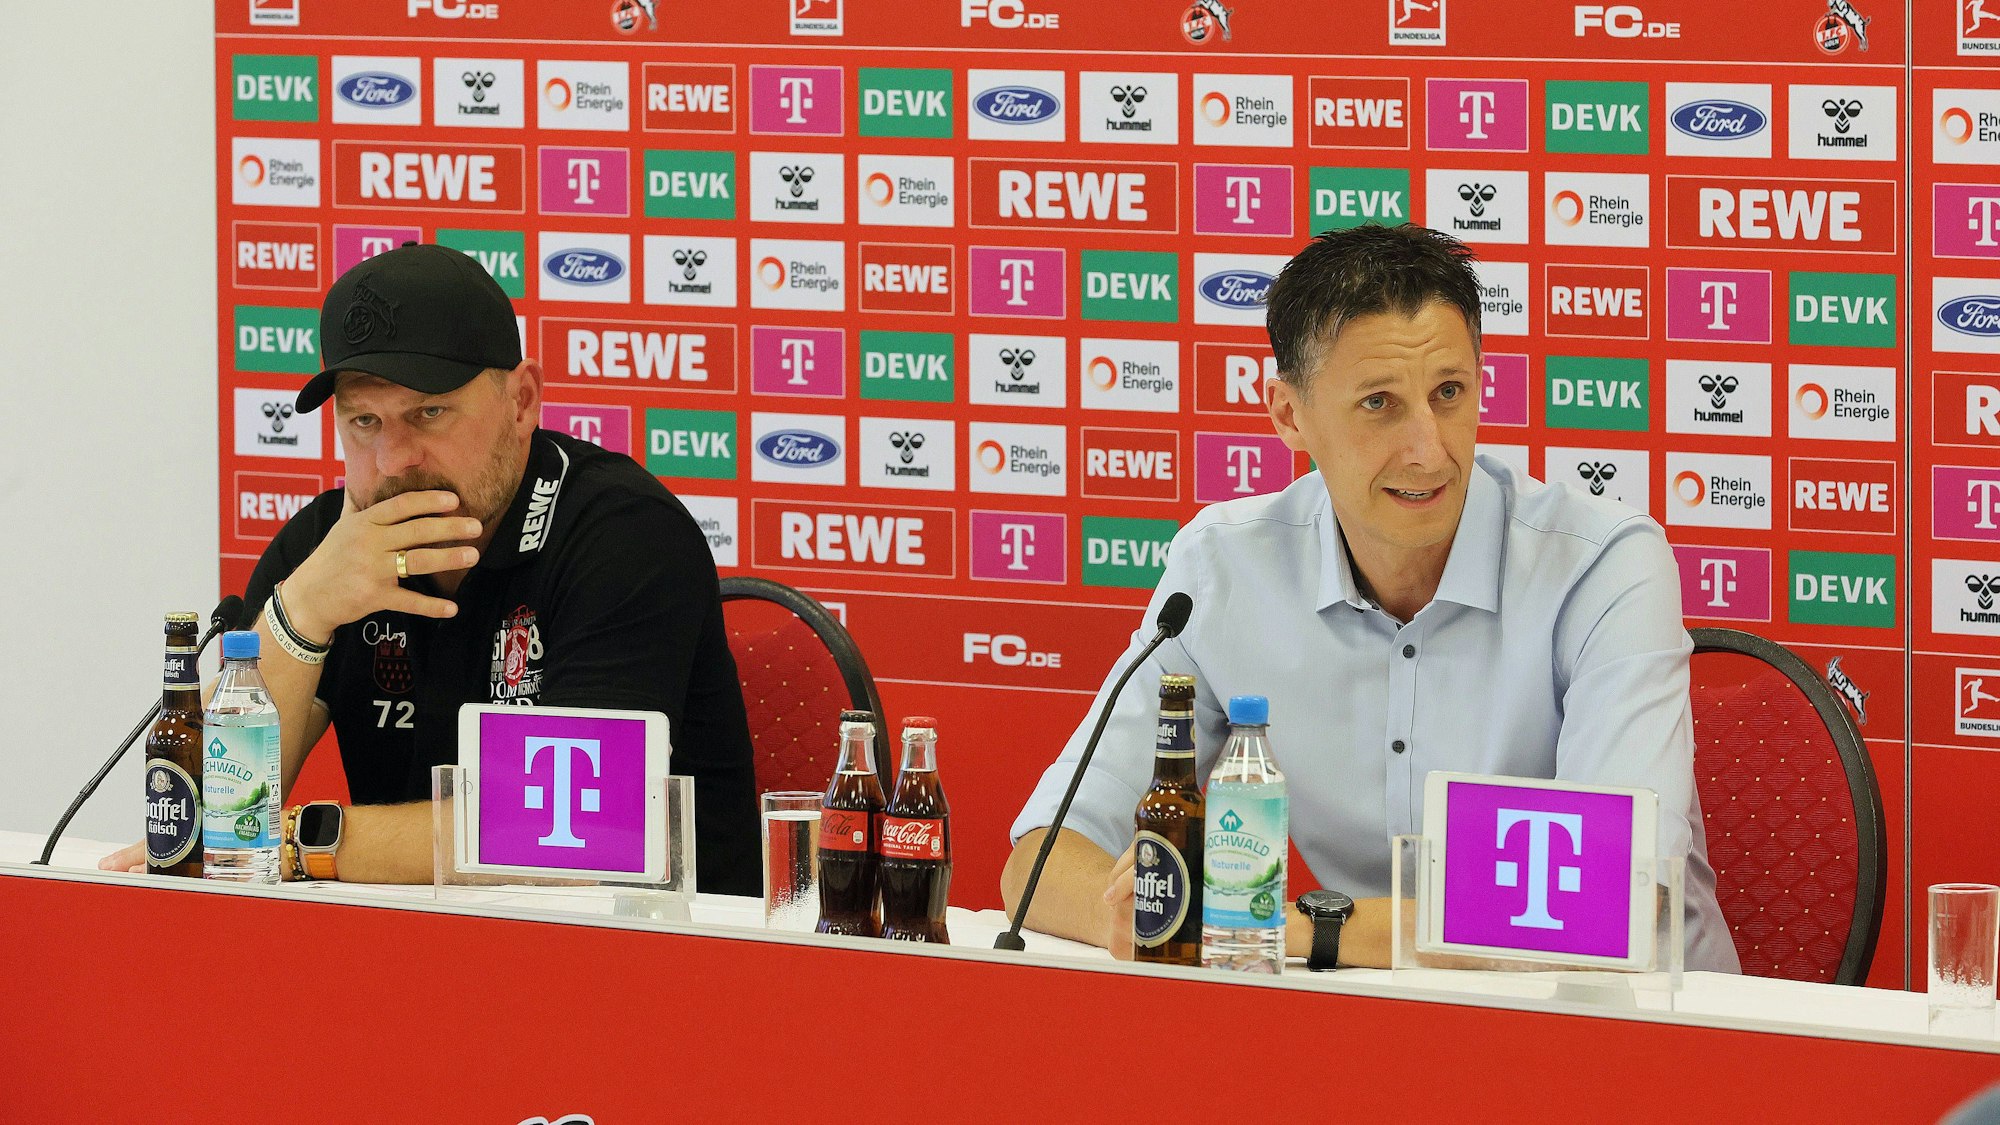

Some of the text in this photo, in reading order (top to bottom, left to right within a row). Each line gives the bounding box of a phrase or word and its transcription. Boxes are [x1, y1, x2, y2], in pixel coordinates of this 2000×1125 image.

[408, 0, 497, 18] FC.DE
[961, 0, 1059, 28] FC.DE
[1575, 6, 1680, 38] FC.DE
[238, 75, 312, 101] DEVK
[352, 78, 399, 105] Ford
[577, 82, 611, 95] Rhein
[649, 84, 729, 112] REWE
[780, 78, 812, 123] T
[459, 104, 499, 114] hummel
[577, 96, 623, 112] Energie
[865, 90, 946, 116] DEVK
[990, 92, 1042, 117] Ford
[1236, 97, 1273, 110] Rhein
[1315, 98, 1403, 127] REWE
[1460, 91, 1494, 139] T
[1107, 118, 1151, 131] hummel
[1237, 111, 1287, 127] Energie
[1552, 104, 1641, 131] DEVK
[1690, 106, 1747, 132] Ford
[1818, 134, 1867, 147] hummel
[269, 159, 303, 172] Rhein
[361, 152, 496, 201] REWE
[270, 172, 314, 188] Energie
[568, 159, 599, 204] T
[650, 171, 729, 198] DEVK
[899, 177, 935, 190] Rhein
[776, 198, 818, 210] hummel
[899, 191, 948, 208] Energie
[999, 170, 1147, 221] REWE
[1227, 177, 1260, 223] T
[1316, 189, 1402, 217] DEVK
[1590, 196, 1628, 209] Rhein
[1454, 217, 1500, 230] hummel
[1590, 211, 1642, 227] Energie
[1700, 188, 1861, 241] REWE
[238, 242, 315, 270] REWE
[468, 250, 519, 277] VK
[560, 254, 608, 279] Ford
[791, 261, 826, 274] Rhein
[669, 282, 711, 293] hummel
[791, 275, 839, 292] Energie
[865, 264, 948, 293] REWE
[1001, 259, 1034, 305] T
[1087, 272, 1171, 300] DEVK
[1482, 285, 1509, 298] hein
[1480, 299, 1523, 313] nergie
[1552, 286, 1642, 317] REWE
[1701, 282, 1736, 329] T
[1796, 295, 1888, 324] DEVK
[1957, 301, 2000, 329] For
[240, 326, 314, 353] DEVK
[568, 330, 708, 381] REWE
[782, 339, 814, 385] T
[866, 352, 947, 380] DEVK
[1123, 362, 1159, 375] Rhein
[996, 381, 1039, 393] hummel
[1123, 376, 1172, 393] Energie
[1553, 379, 1641, 408] DEVK
[1835, 389, 1874, 403] Rhein
[1695, 408, 1742, 422] hummel
[1835, 404, 1889, 421] Energie
[259, 434, 297, 445] hummel
[651, 429, 730, 458] DEVK
[773, 435, 823, 461] Ford
[1011, 445, 1047, 459] Rhein
[886, 464, 928, 477] hummel
[1011, 459, 1060, 477] Energie
[1087, 449, 1173, 480] REWE
[1227, 446, 1261, 492] T
[1712, 477, 1750, 491] Rhein
[1796, 480, 1889, 512] REWE
[1712, 492, 1765, 509] Energie
[519, 477, 559, 552] REWE
[782, 512, 925, 565] REWE
[1002, 524, 1034, 570] T
[1701, 559, 1736, 607] T
[1796, 574, 1887, 604] DEVK
[266, 609, 285, 642] ERFOLG
[283, 641, 296, 653] IST
[297, 651, 318, 662] KEIN
[964, 633, 1061, 667] FC.DE
[373, 700, 415, 729] 72
[1960, 722, 2000, 731] BUNDESLI
[1158, 723, 1178, 738] affel
[204, 761, 253, 782] CHWALD
[525, 736, 600, 848] T
[1495, 808, 1582, 930] T
[1135, 872, 1176, 899] affel
